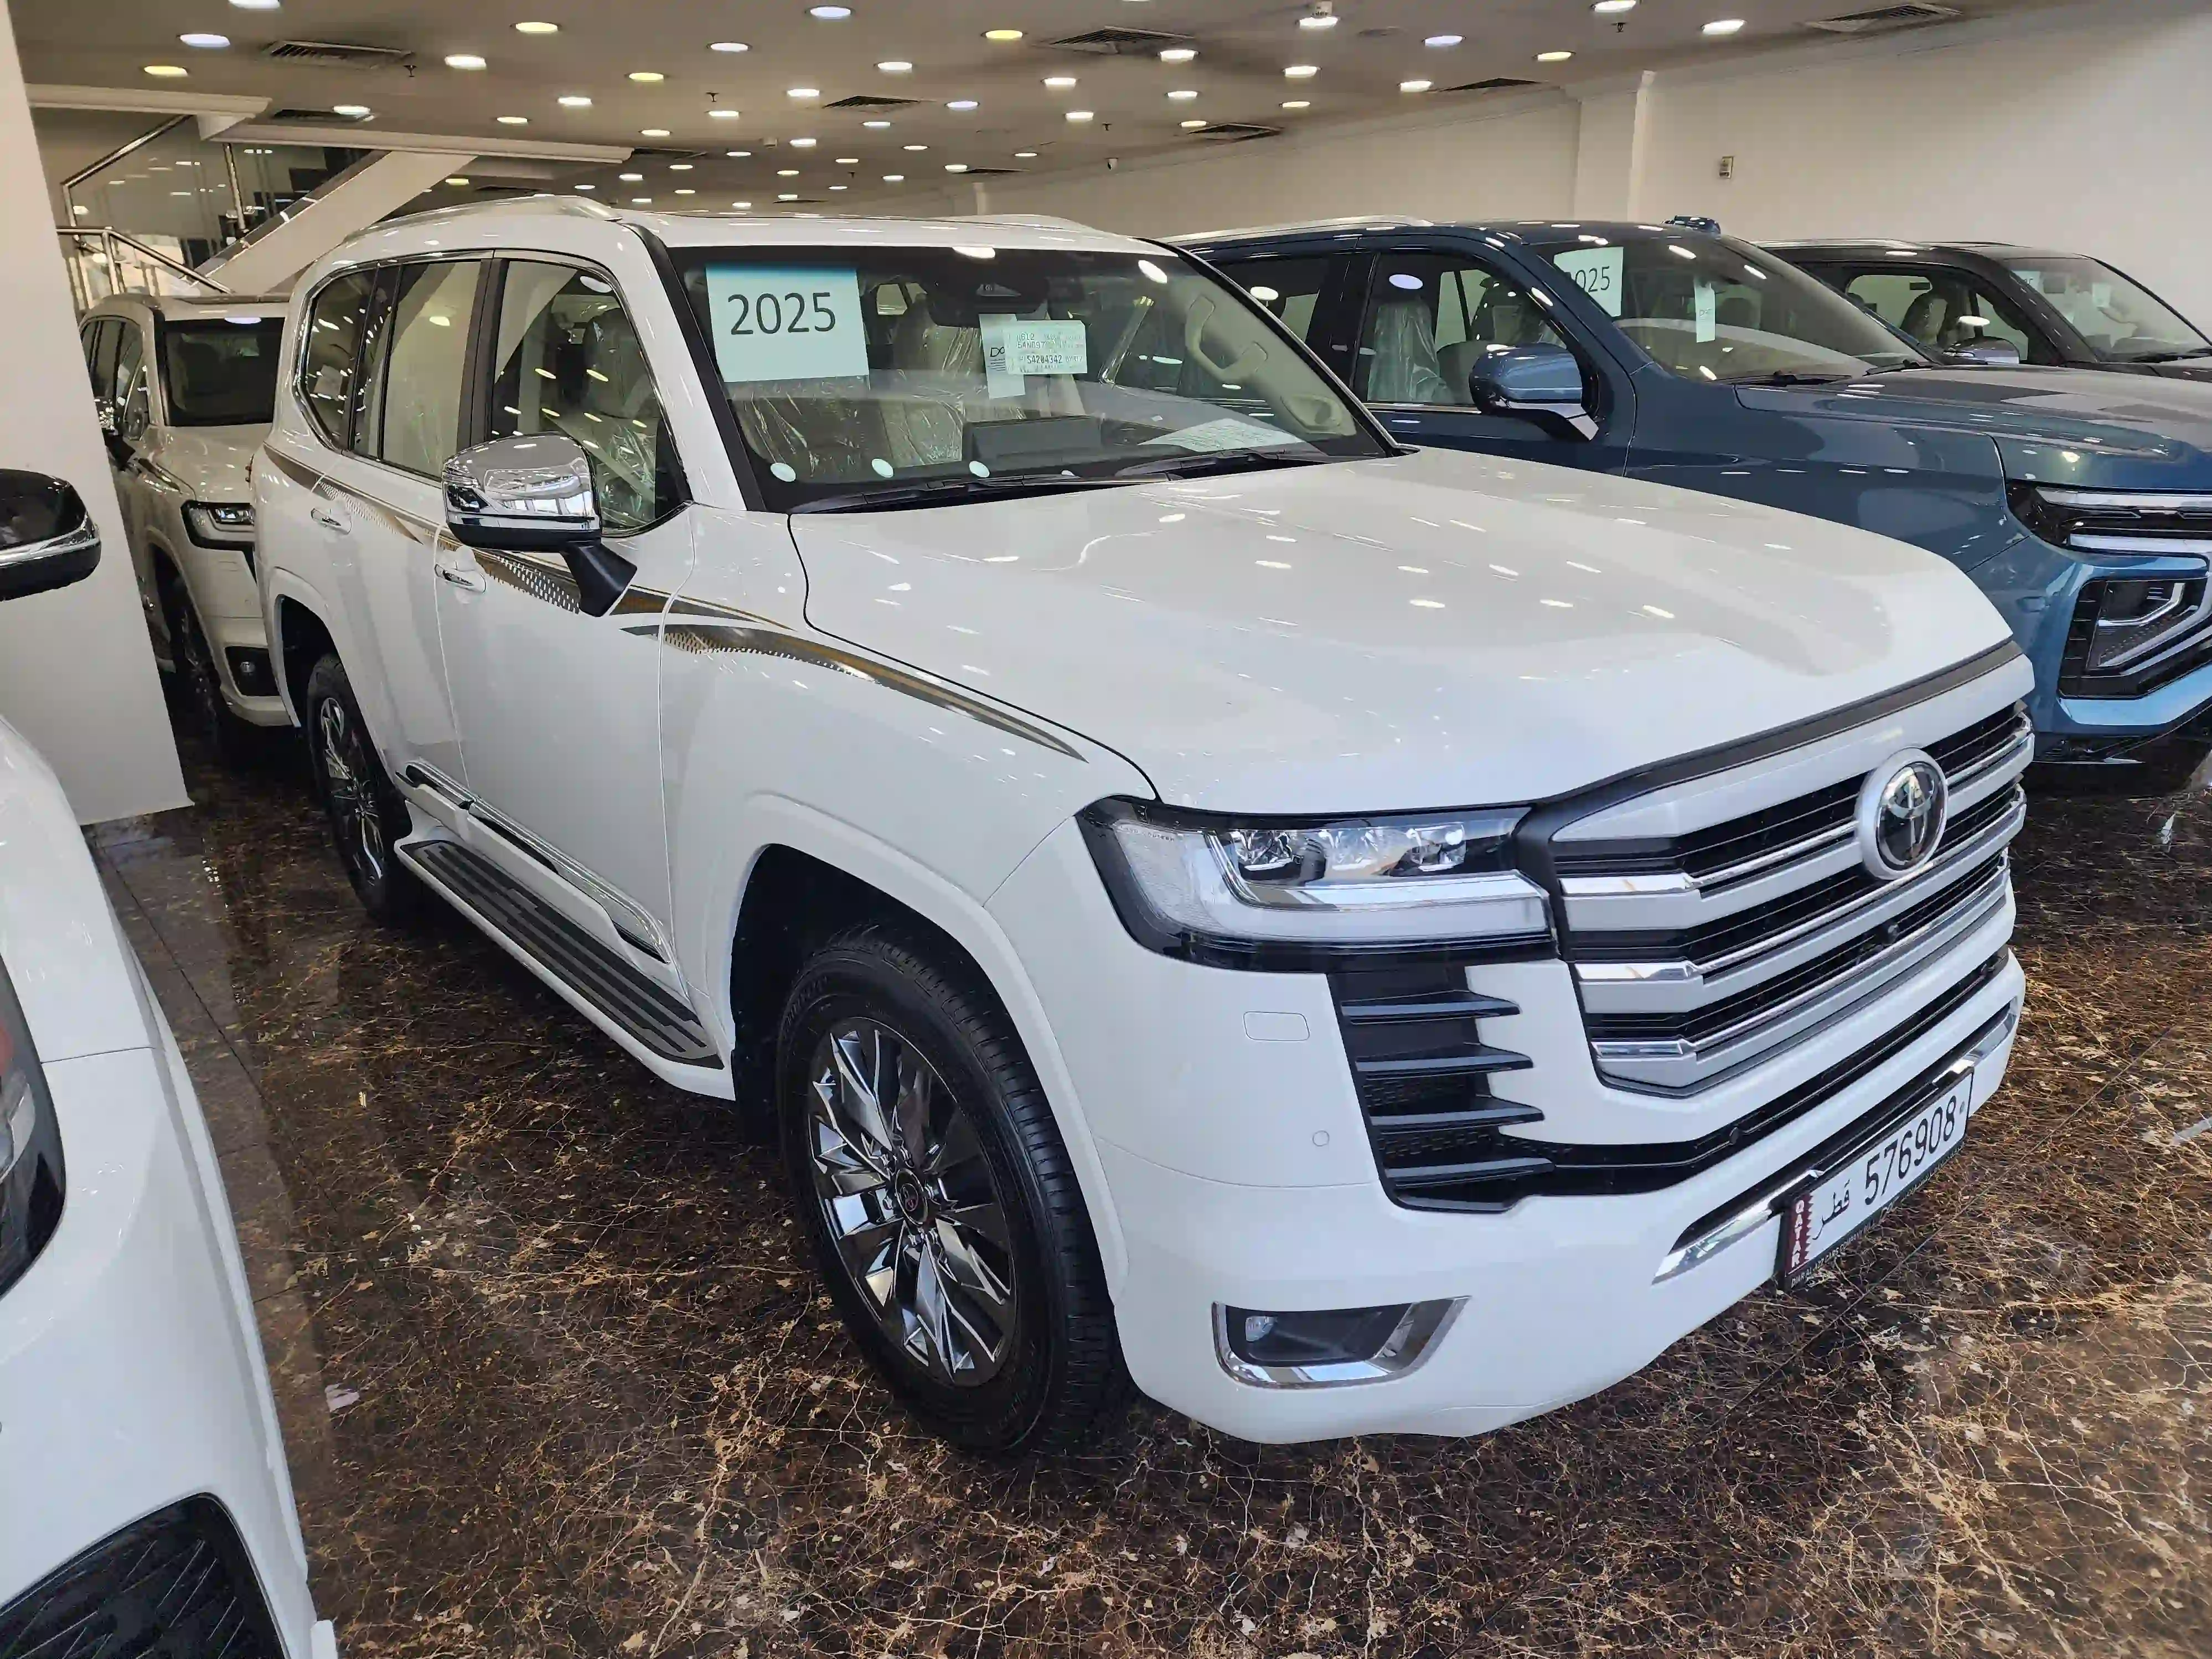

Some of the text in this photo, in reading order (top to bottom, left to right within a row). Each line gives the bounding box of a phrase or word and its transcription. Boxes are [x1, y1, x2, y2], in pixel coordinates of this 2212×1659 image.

[1564, 266, 1610, 292] 025
[727, 291, 836, 335] 2025
[1864, 1095, 1957, 1206] 576908
[1791, 1199, 1805, 1268] QATAR
[1812, 1179, 1851, 1241] قطر
